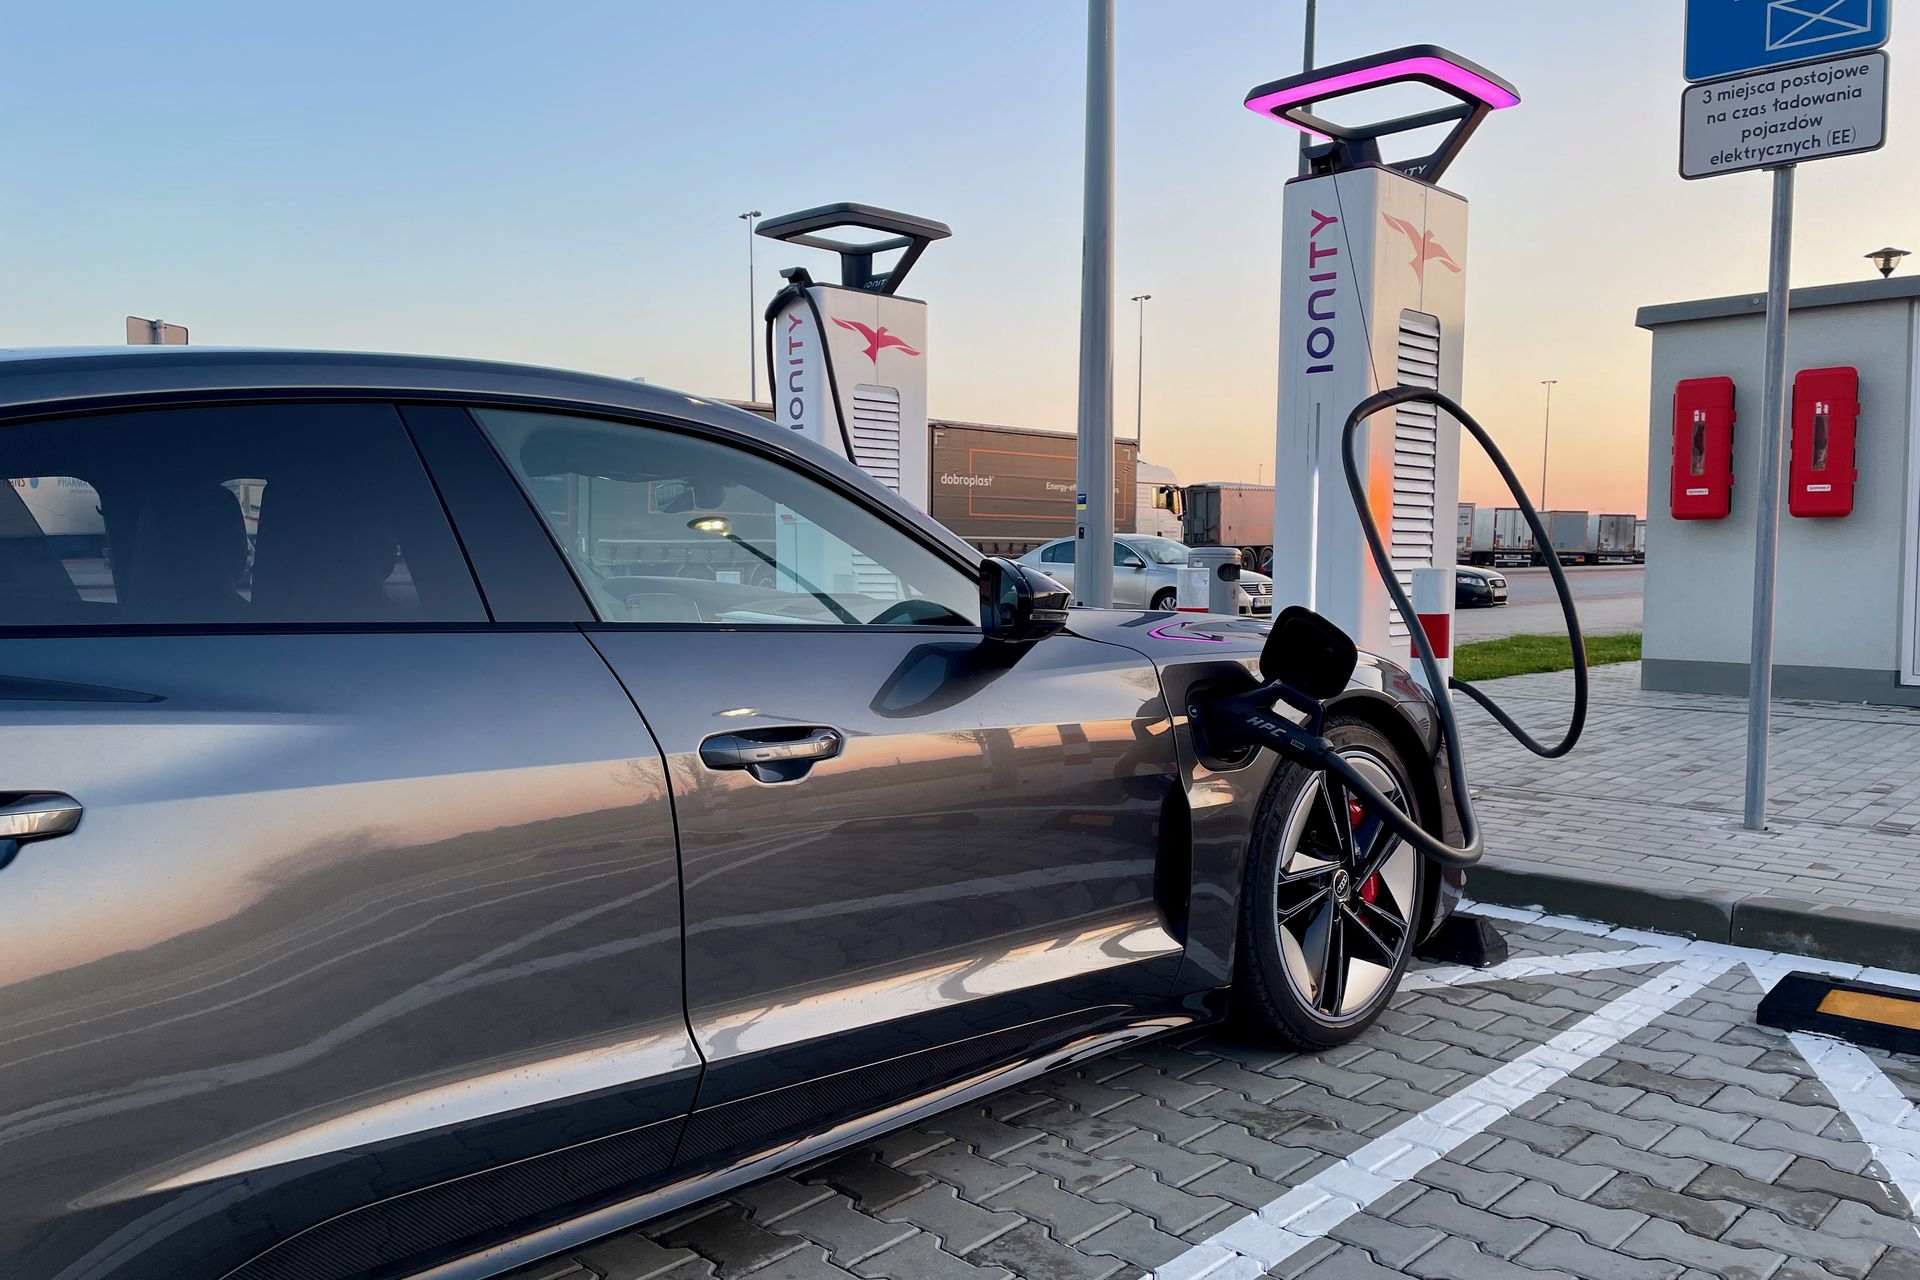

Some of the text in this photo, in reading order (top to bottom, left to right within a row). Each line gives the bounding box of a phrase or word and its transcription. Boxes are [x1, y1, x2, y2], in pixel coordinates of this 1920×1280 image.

[1702, 63, 1870, 104] 3 miejsca postojowe
[1706, 86, 1863, 125] na czas ładowania
[1741, 113, 1823, 143] pojazdów
[1710, 126, 1857, 166] elektrycznych (EE)
[1403, 164, 1428, 176] ITY
[864, 278, 887, 289] IONIT
[1306, 209, 1339, 374] IONITY
[788, 313, 804, 431] IONITY
[940, 472, 993, 488] dobroplast
[1046, 481, 1077, 493] Energy-ef
[1246, 716, 1287, 738] HPC
